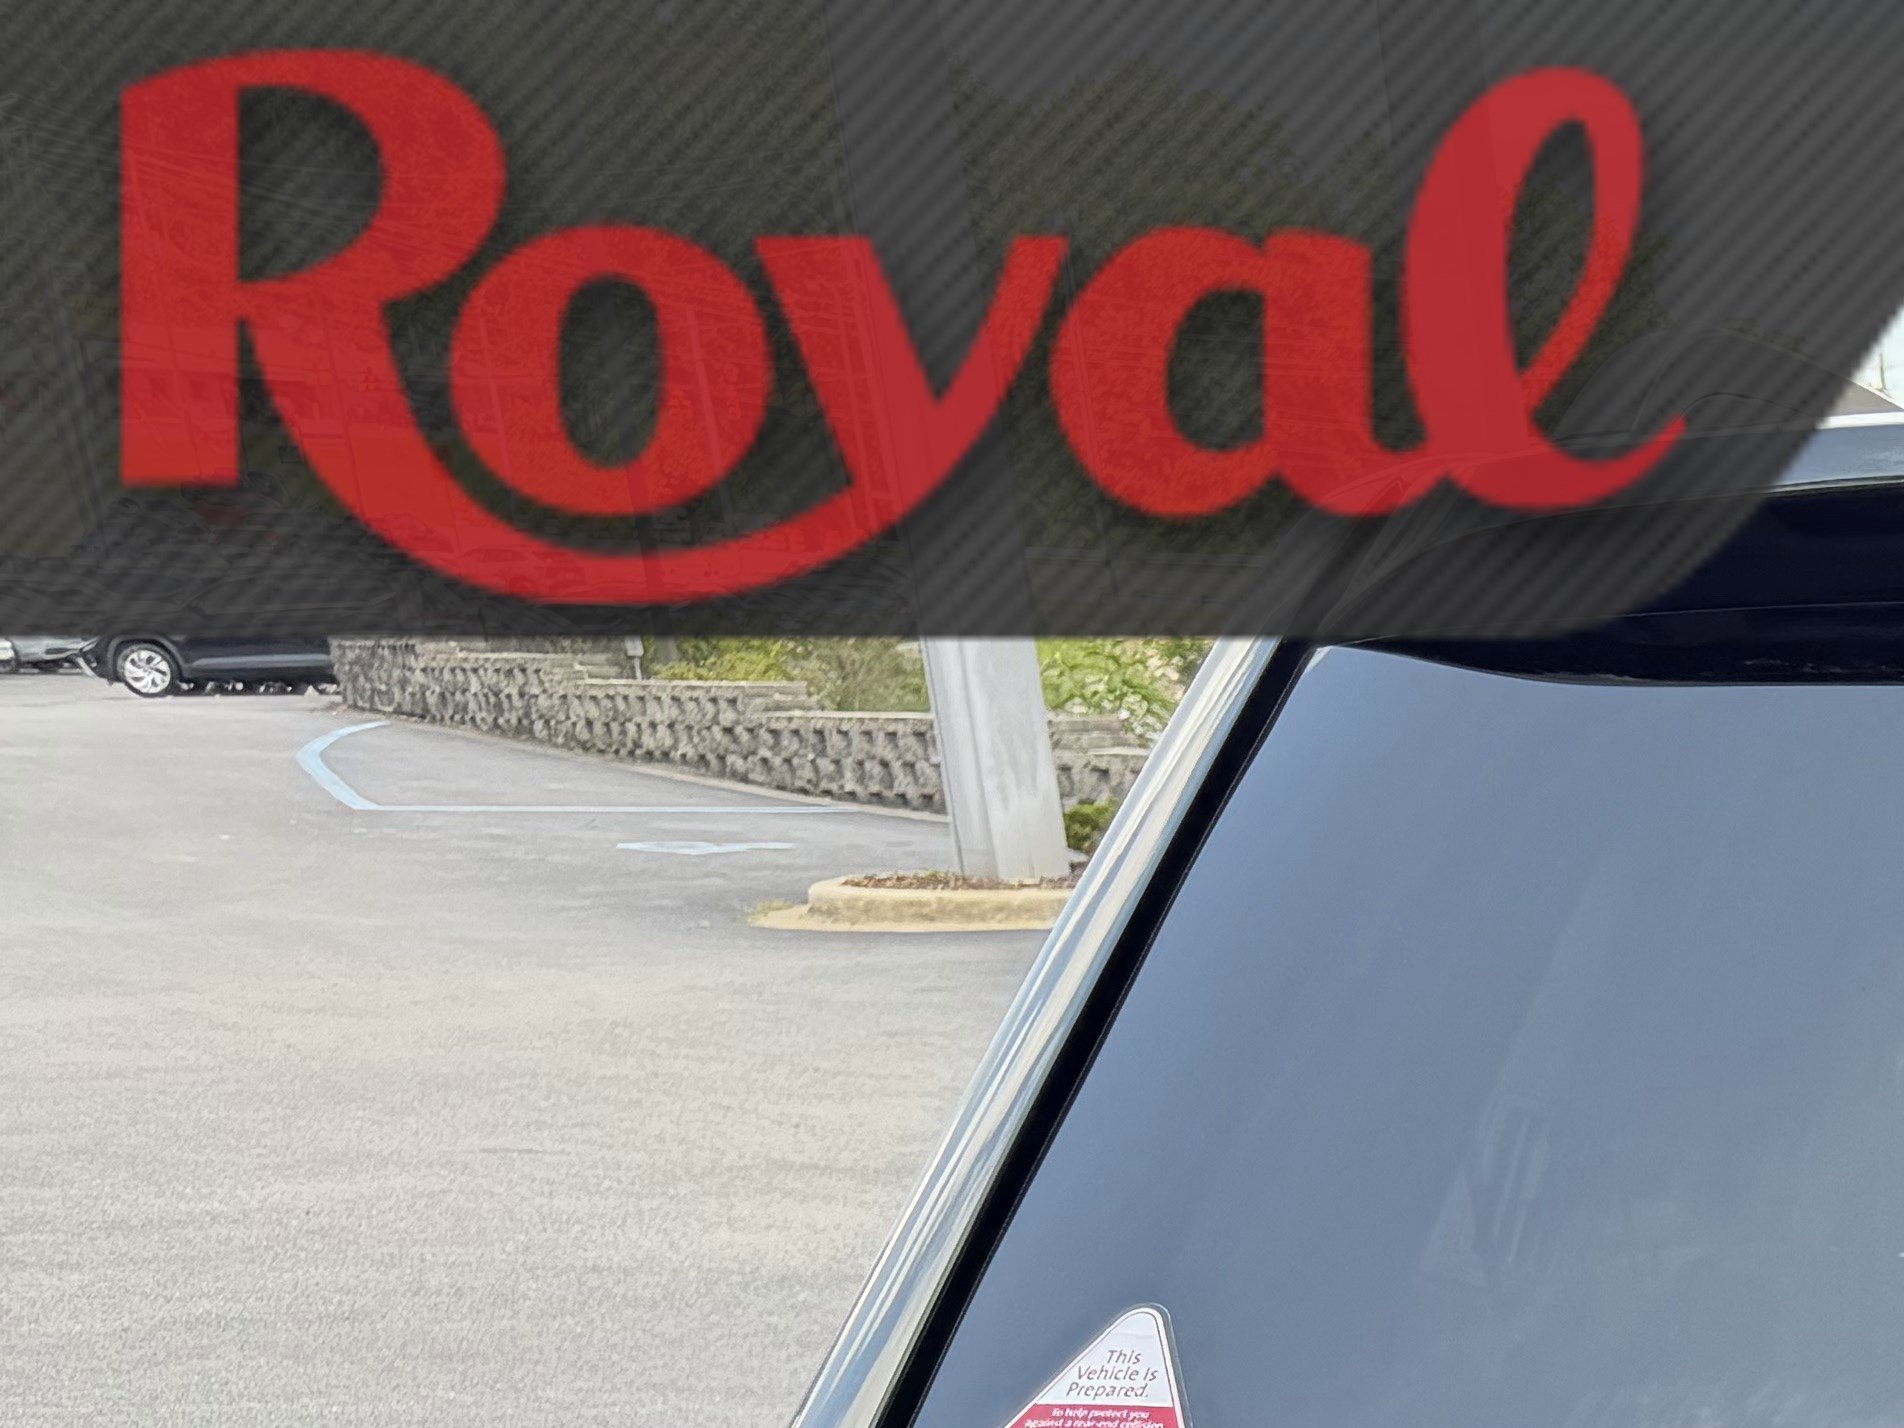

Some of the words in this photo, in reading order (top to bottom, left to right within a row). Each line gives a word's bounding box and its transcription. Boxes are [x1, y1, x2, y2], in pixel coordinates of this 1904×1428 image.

[1106, 1349, 1142, 1365] This
[1076, 1365, 1139, 1382] Vehicle
[1143, 1367, 1159, 1382] Is
[1066, 1381, 1150, 1400] Prepared.
